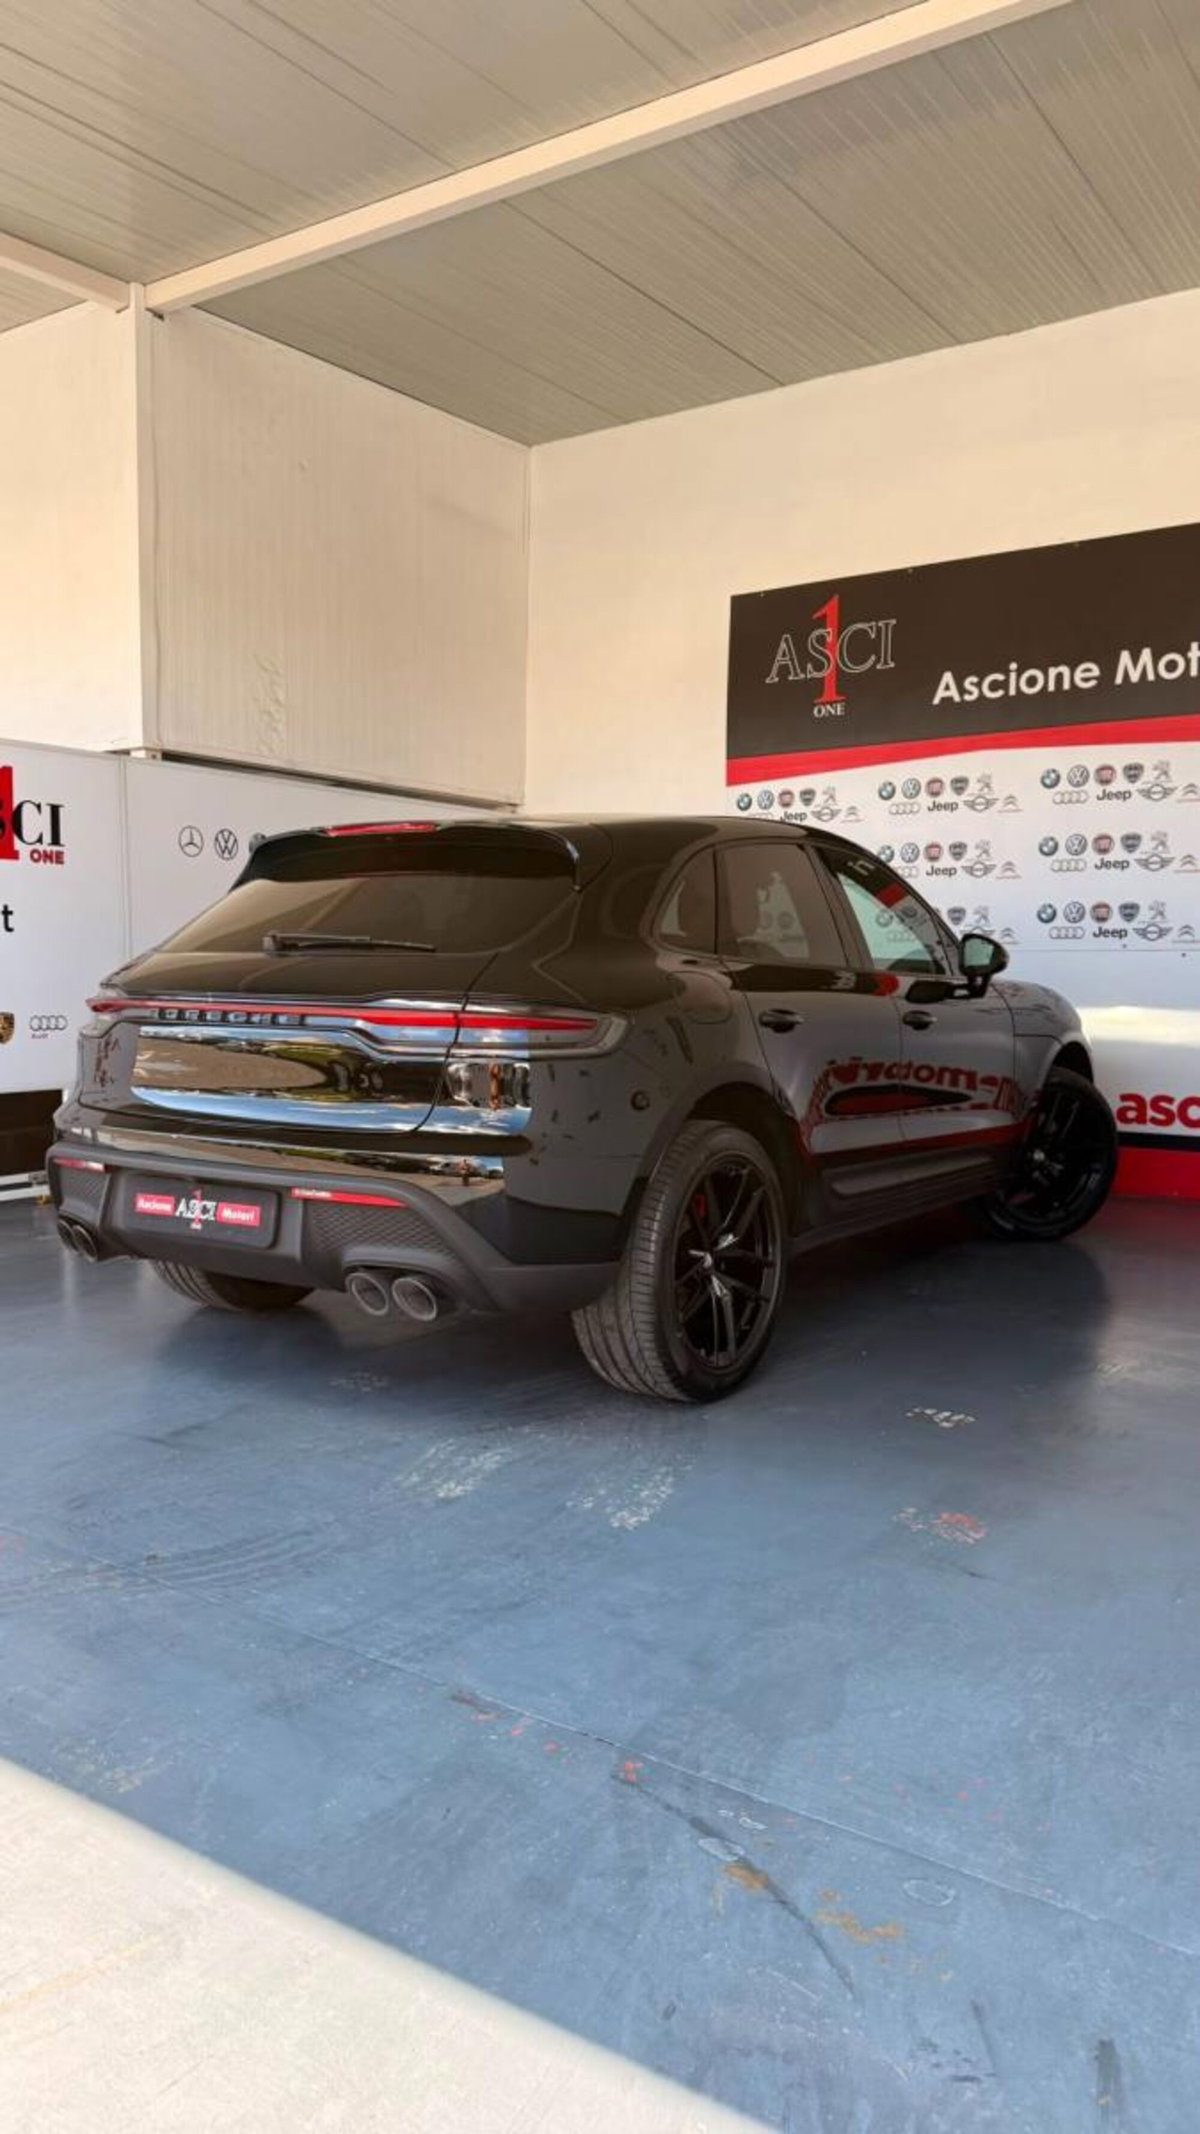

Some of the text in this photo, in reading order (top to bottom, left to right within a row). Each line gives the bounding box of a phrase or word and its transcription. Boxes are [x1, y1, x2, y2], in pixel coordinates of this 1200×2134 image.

[765, 618, 896, 683] ASCI
[932, 641, 1200, 705] Ascione Mot
[813, 702, 845, 717] ONE
[1096, 788, 1132, 801] Jeep
[927, 800, 959, 813] Jeep
[0, 799, 65, 847] CI
[30, 848, 65, 865] ONE
[1094, 857, 1130, 870] Jeep
[925, 865, 957, 877] Jeep
[1092, 926, 1128, 939] Jeep
